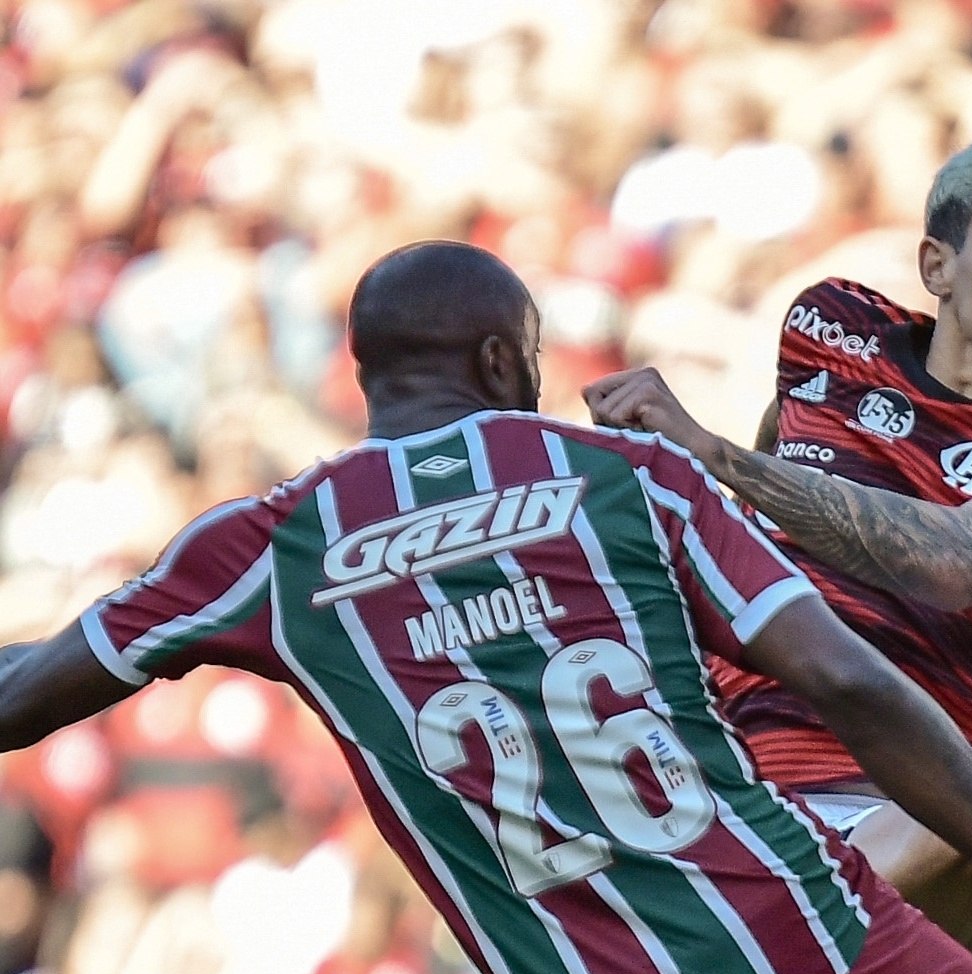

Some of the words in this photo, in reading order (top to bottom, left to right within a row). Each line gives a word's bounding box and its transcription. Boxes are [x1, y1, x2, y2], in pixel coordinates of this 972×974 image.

[784, 305, 881, 363] pixbet
[403, 576, 567, 662] MANOEL
[480, 696, 509, 738] TIM
[416, 638, 717, 898] 26
[646, 730, 676, 770] TIM
